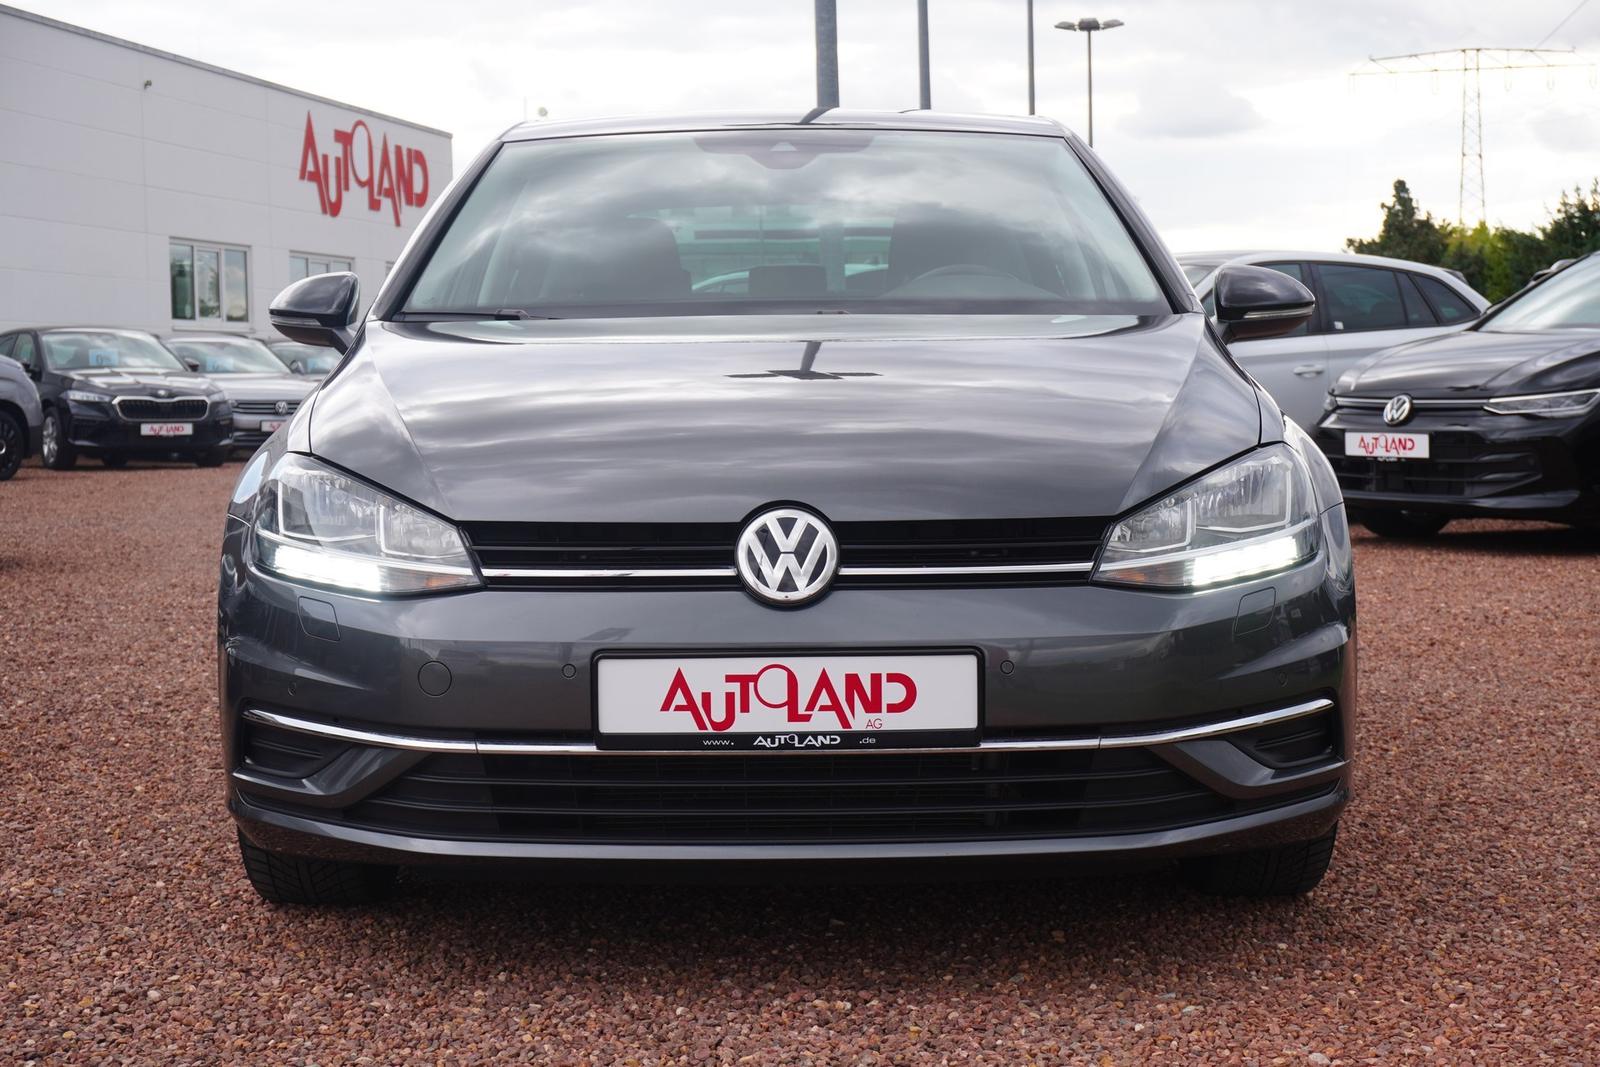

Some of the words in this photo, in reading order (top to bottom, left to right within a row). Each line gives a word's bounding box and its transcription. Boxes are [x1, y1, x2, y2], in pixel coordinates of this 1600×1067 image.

[299, 109, 430, 228] AUTOLAND
[149, 424, 184, 437] AUTLAND
[1358, 434, 1415, 455] AUTOLAND
[742, 512, 833, 597] VW
[660, 663, 918, 732] AUTOLAND
[865, 718, 883, 729] AG
[753, 733, 841, 748] AUTOLAND
[859, 736, 876, 744] .de
